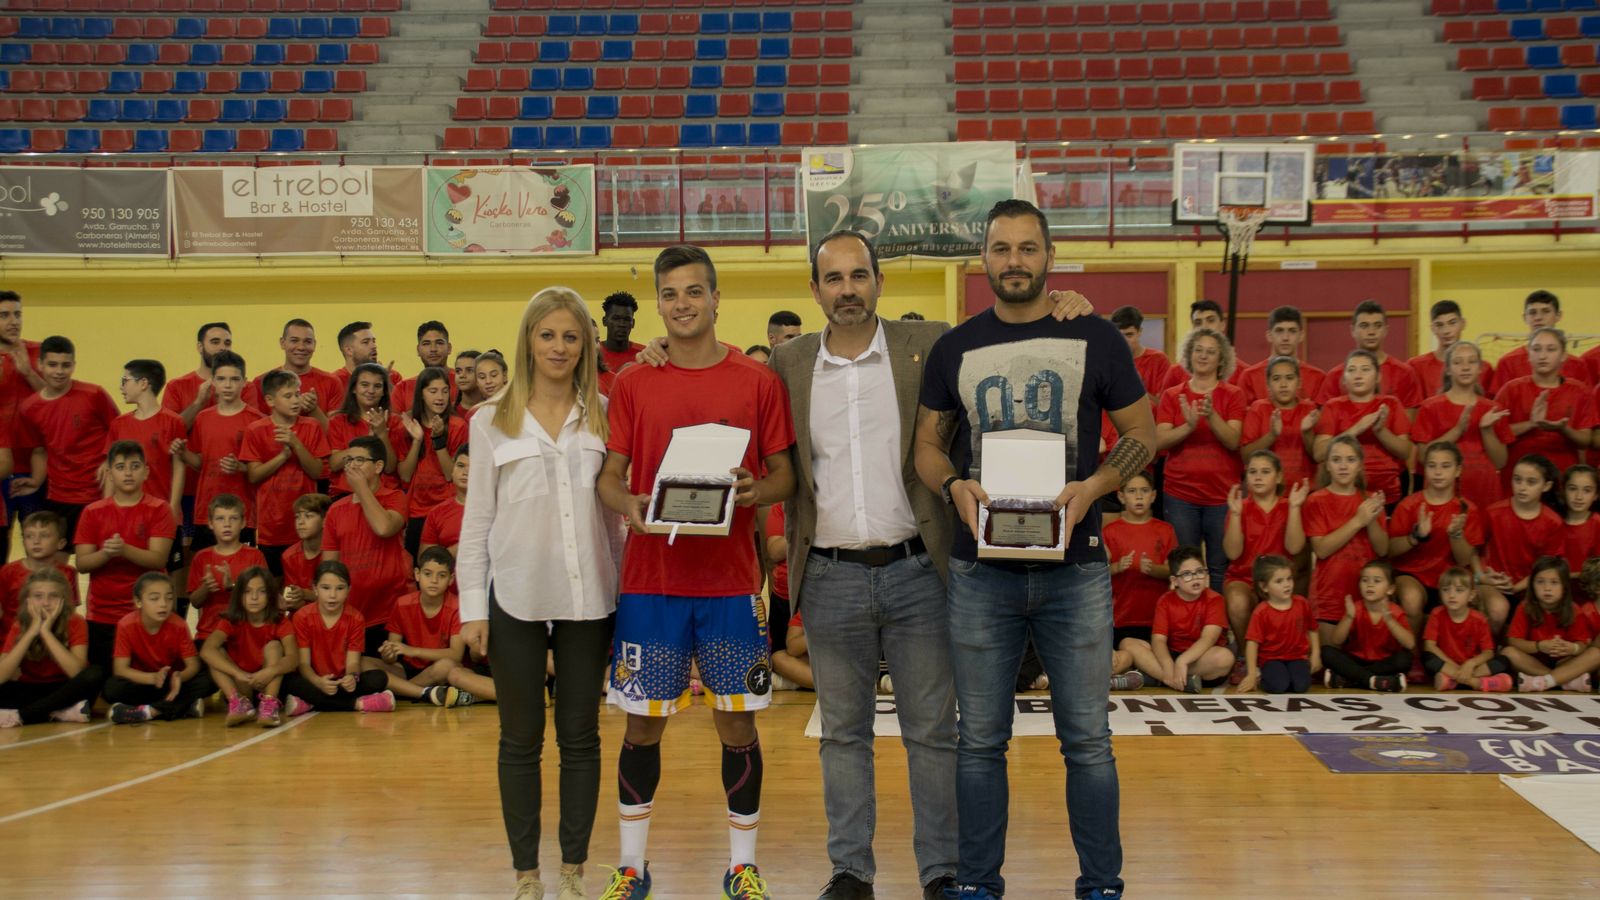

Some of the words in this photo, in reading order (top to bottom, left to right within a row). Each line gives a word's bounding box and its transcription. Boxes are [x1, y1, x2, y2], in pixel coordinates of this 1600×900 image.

[231, 170, 257, 197] el
[273, 169, 368, 196] trebol
[81, 208, 106, 220] 950
[110, 208, 133, 220] 130
[137, 208, 160, 220] 905
[250, 201, 276, 214] Bar
[282, 201, 293, 214] &
[299, 200, 347, 213] Hostel
[473, 192, 513, 225] Kiosko
[350, 217, 371, 228] 950
[375, 217, 395, 228] 130
[398, 217, 418, 228] 434
[489, 221, 532, 229] Carboneras
[887, 222, 987, 236] ANIVERSARI
[75, 232, 123, 240] Carboneras
[922, 241, 984, 253] navegando
[1404, 697, 1583, 713] CON
[1477, 738, 1568, 760] EM
